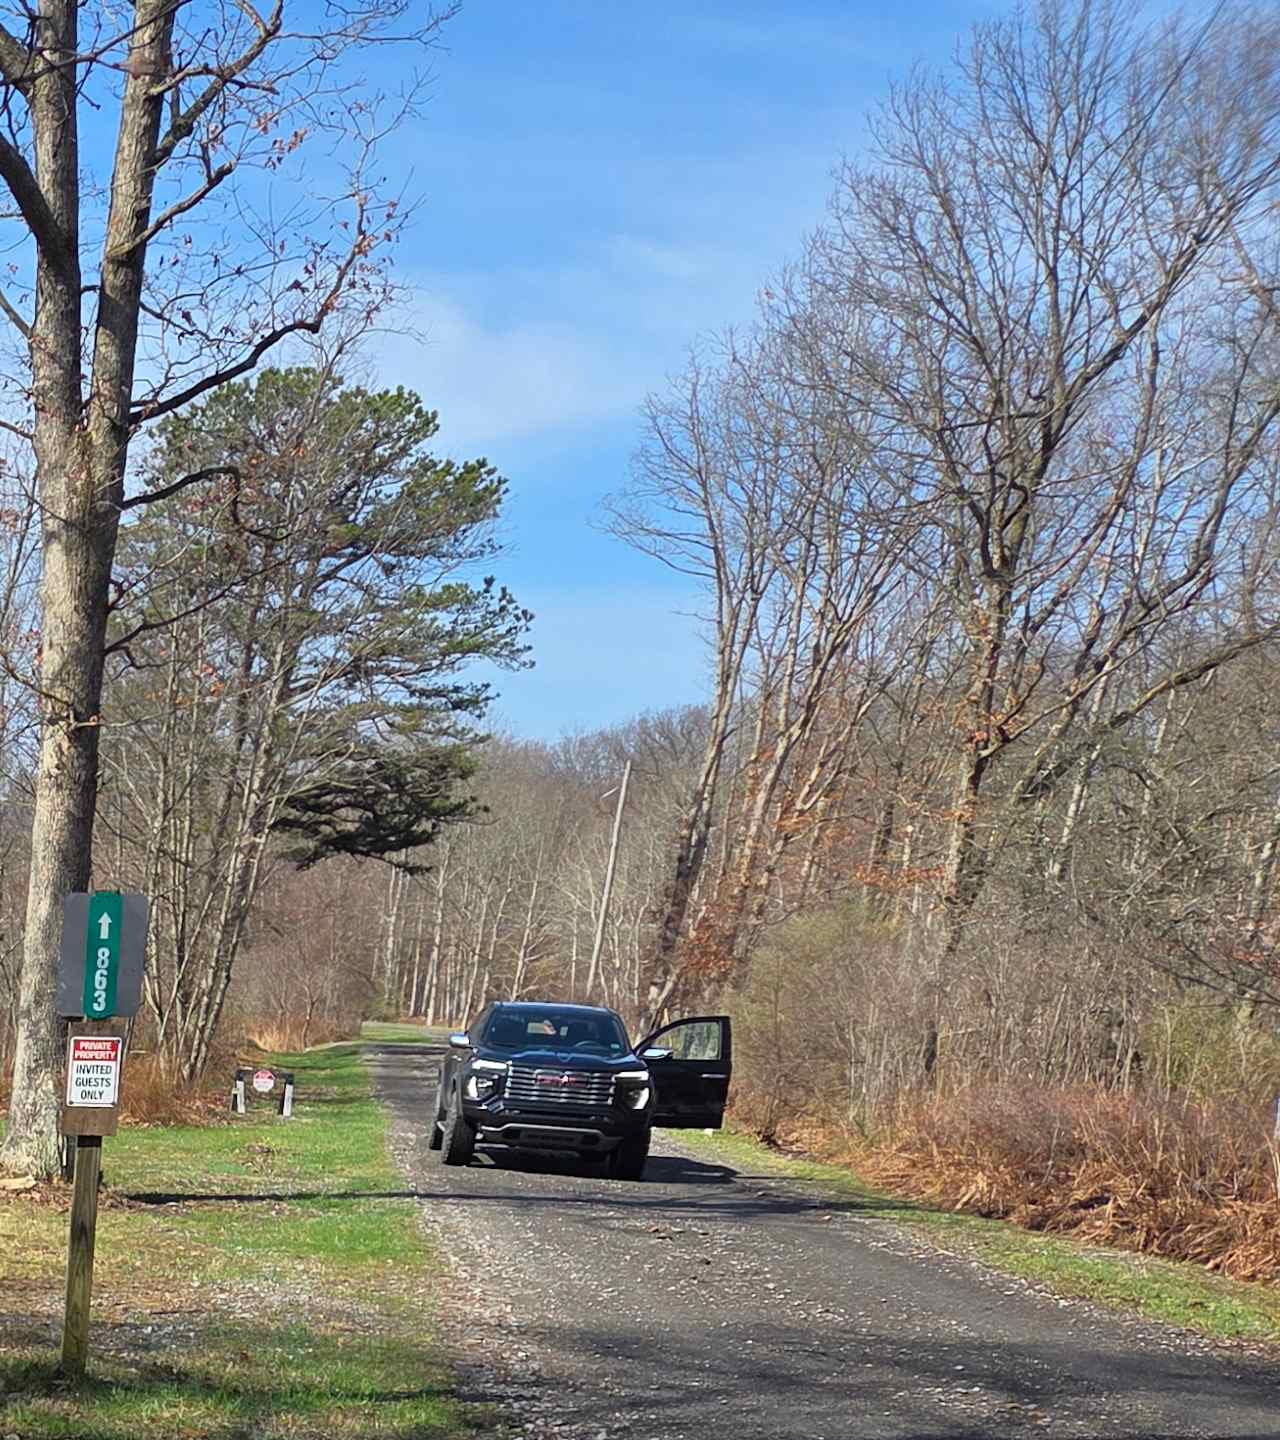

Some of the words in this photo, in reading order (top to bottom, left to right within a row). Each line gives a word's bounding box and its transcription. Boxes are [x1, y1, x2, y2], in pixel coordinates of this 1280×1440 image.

[92, 946, 111, 1012] 863
[79, 1041, 113, 1050] PRIVATE
[74, 1050, 116, 1060] PROPERTY
[76, 1064, 113, 1075] INVITED
[75, 1077, 112, 1088] GUESTS
[80, 1089, 105, 1100] ONLY
